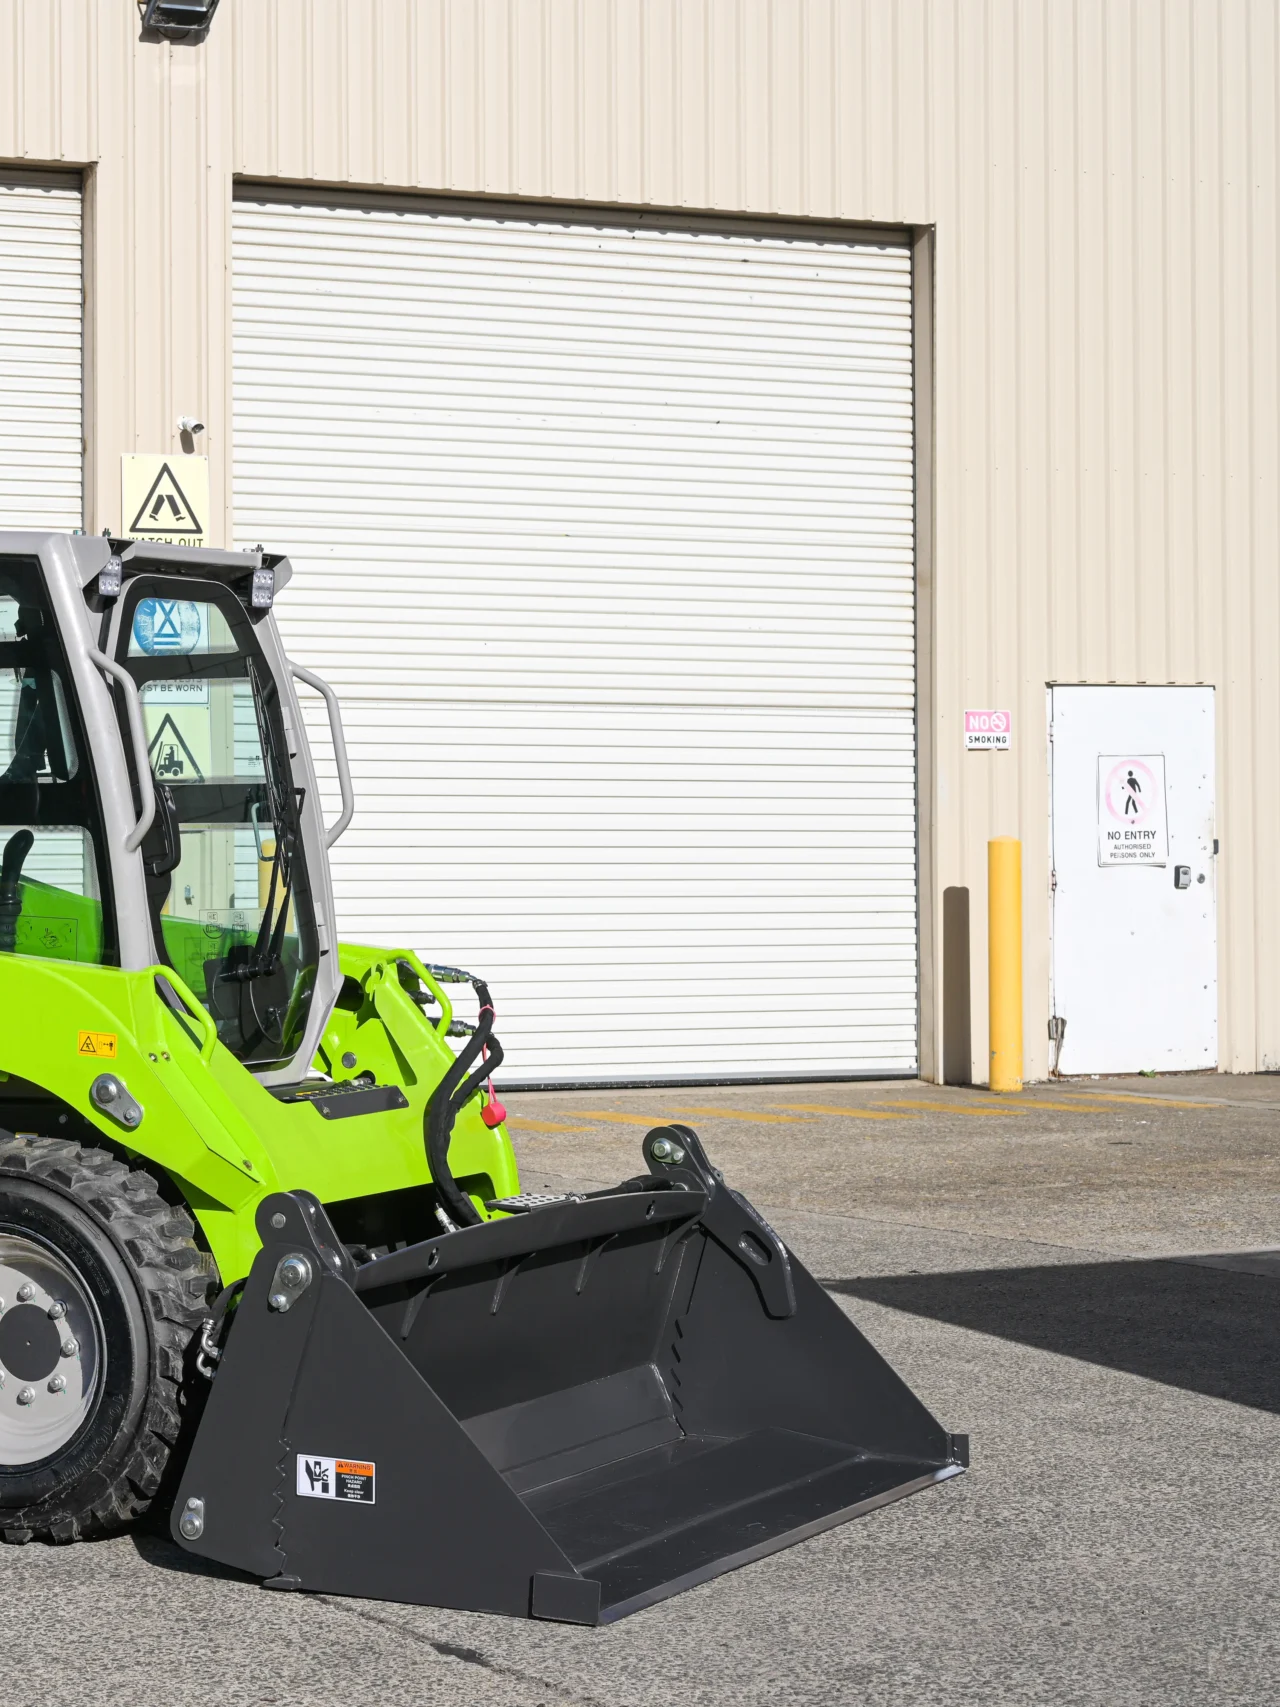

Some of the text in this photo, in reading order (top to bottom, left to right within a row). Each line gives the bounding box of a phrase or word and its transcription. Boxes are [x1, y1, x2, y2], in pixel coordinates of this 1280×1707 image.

[139, 684, 203, 692] UST BE WORN
[969, 715, 989, 730] NO
[968, 735, 1007, 744] SMOKING
[1107, 830, 1156, 840] NO ENTRY
